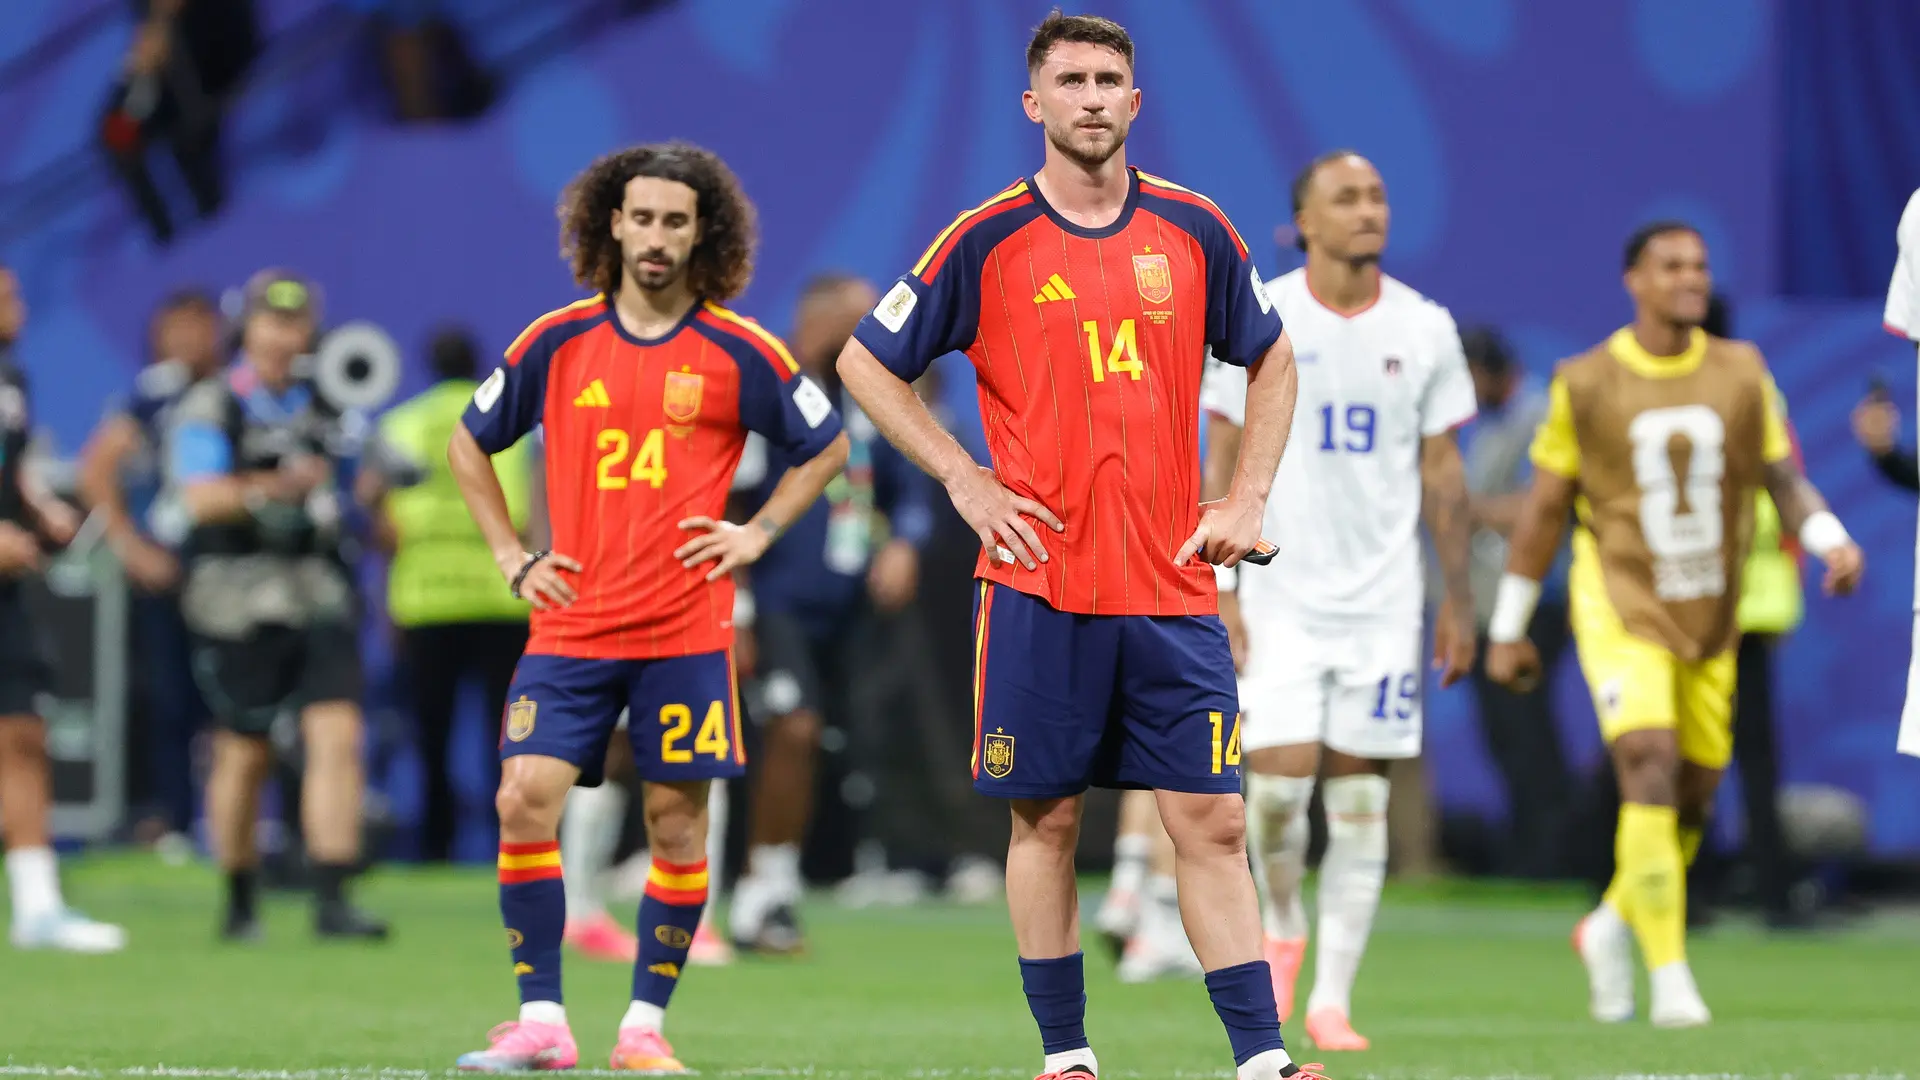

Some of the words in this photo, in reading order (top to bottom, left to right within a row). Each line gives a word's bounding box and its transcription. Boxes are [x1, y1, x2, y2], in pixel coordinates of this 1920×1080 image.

[1083, 318, 1143, 383] 14
[596, 428, 667, 490] 24
[1318, 403, 1377, 453] 19
[1372, 673, 1420, 720] 19
[659, 700, 730, 764] 24
[1208, 711, 1241, 775] 14
